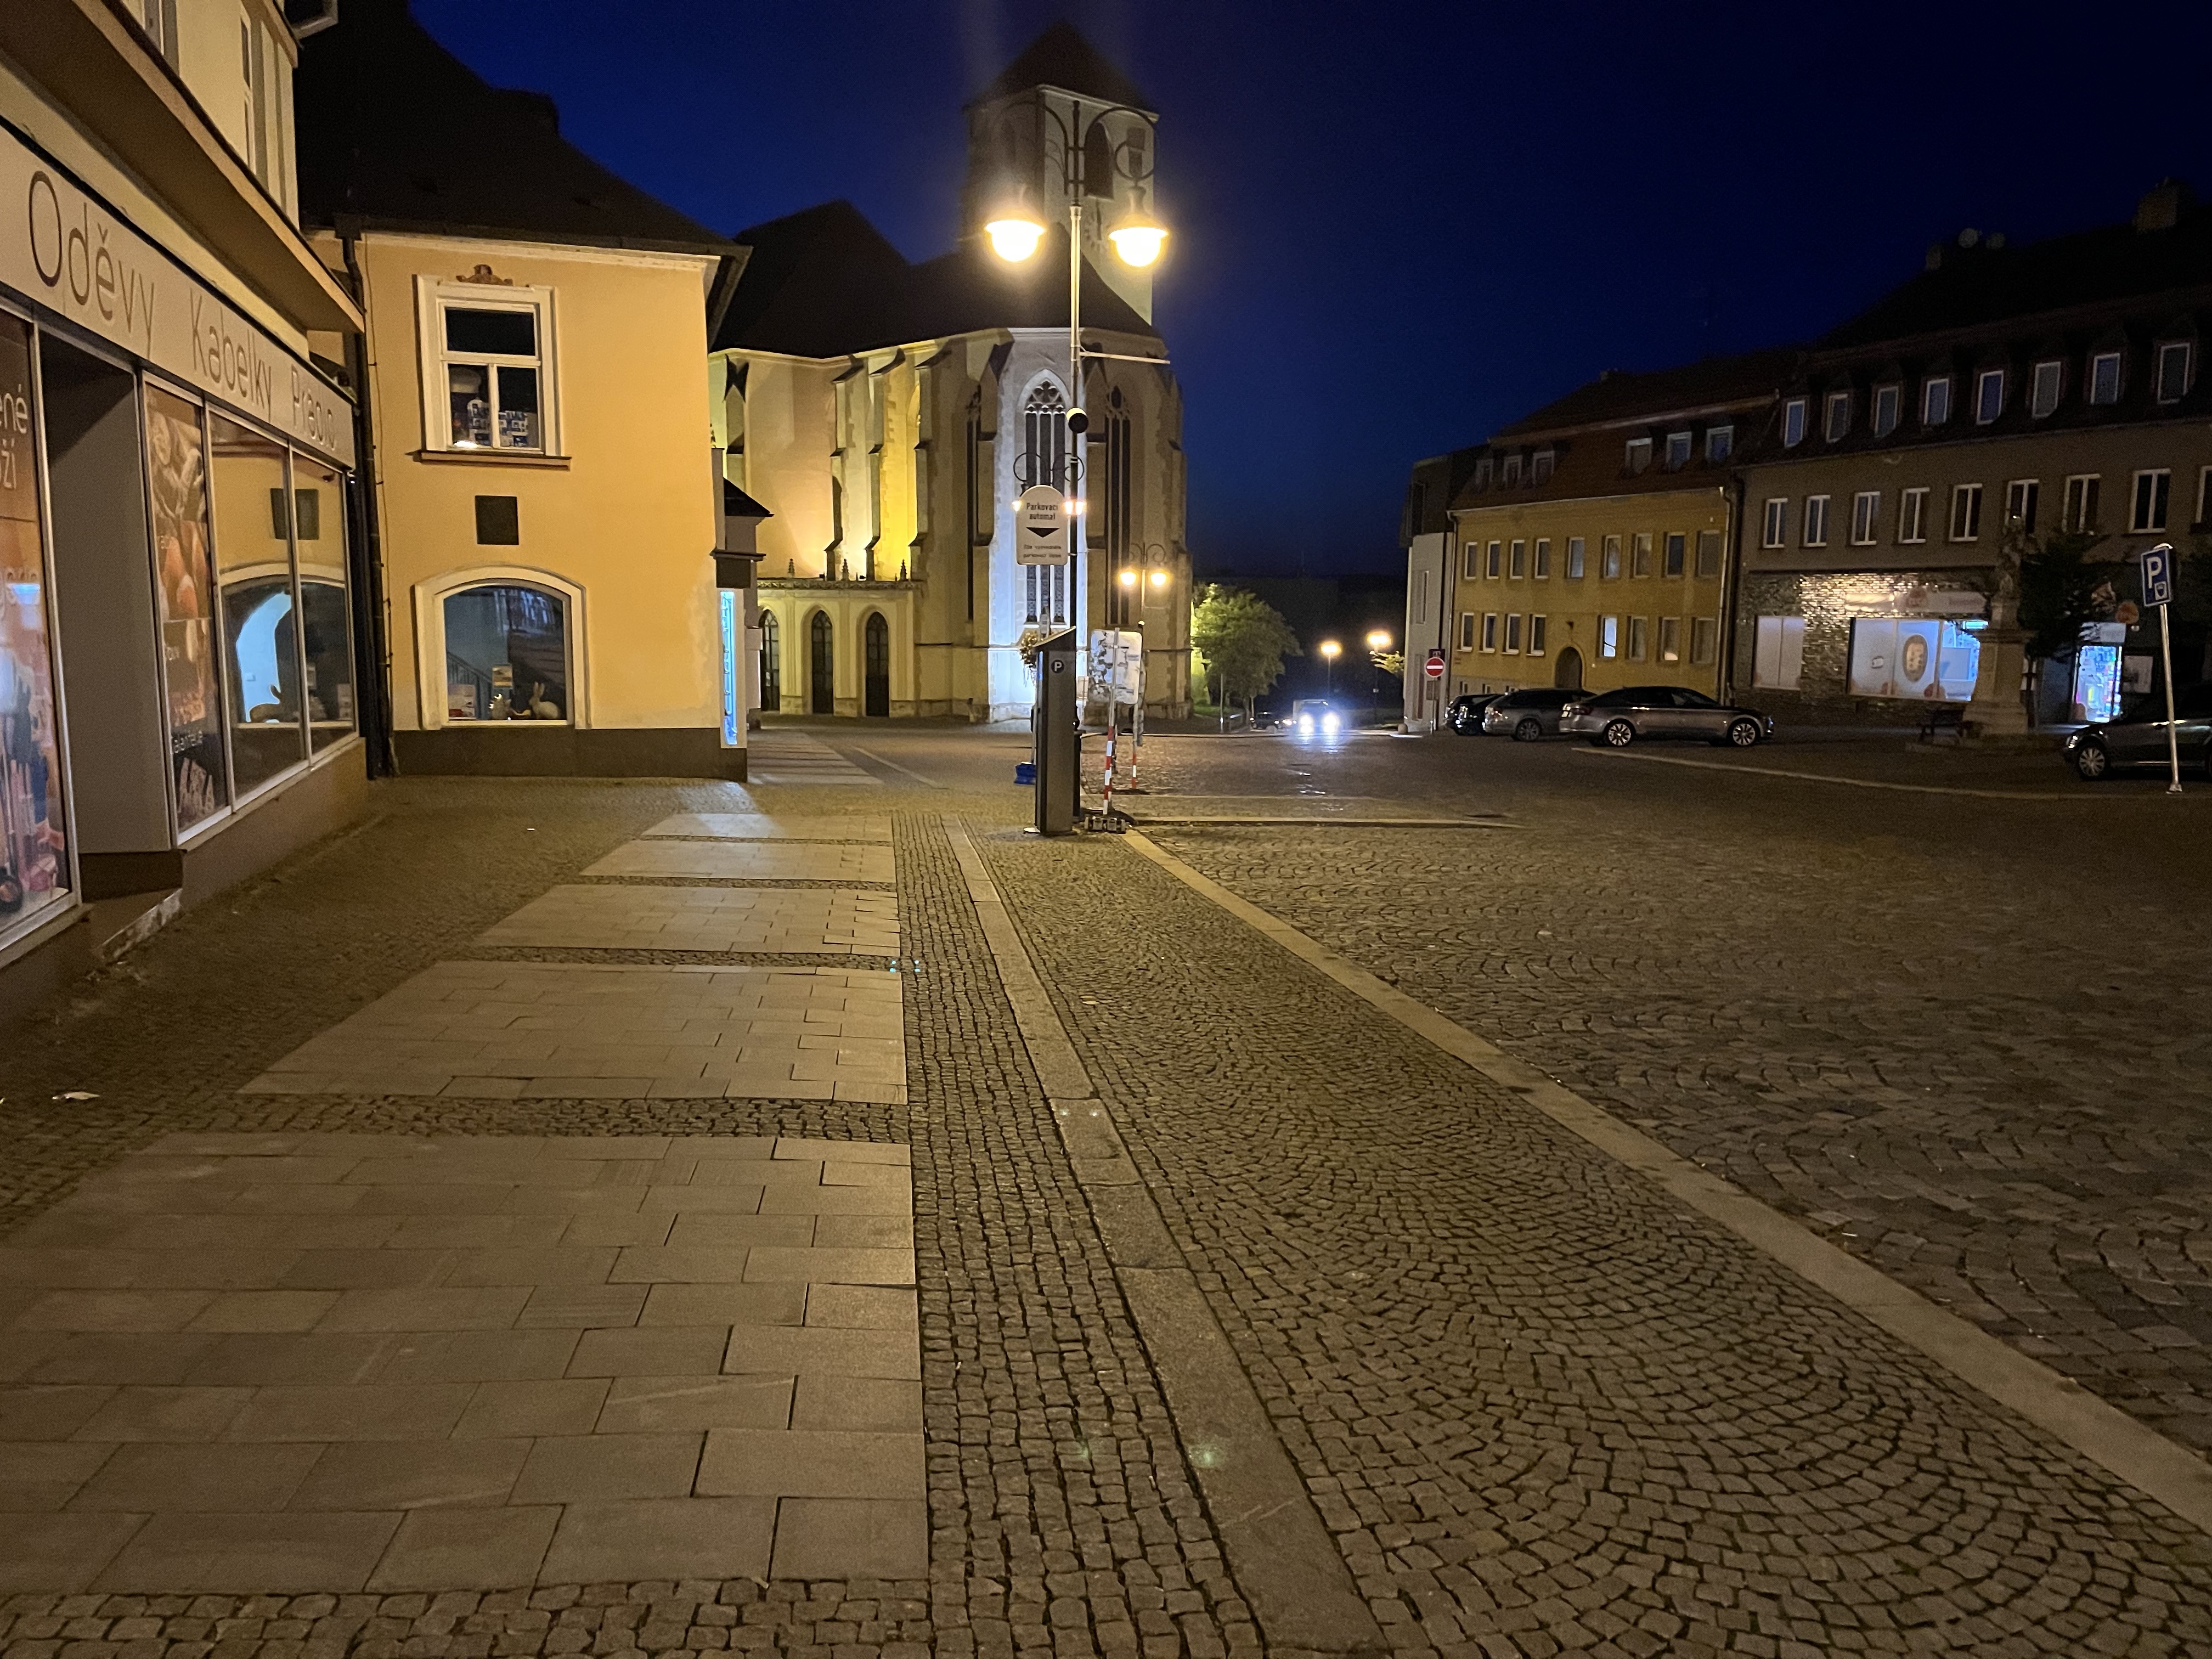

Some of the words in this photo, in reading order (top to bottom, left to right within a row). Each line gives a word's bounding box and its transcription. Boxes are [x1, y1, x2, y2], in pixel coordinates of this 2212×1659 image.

[29, 170, 155, 360] Oděvy
[190, 286, 272, 424] Kabelky
[0, 383, 28, 433] né
[2147, 556, 2162, 589] P
[1054, 662, 1062, 672] P
